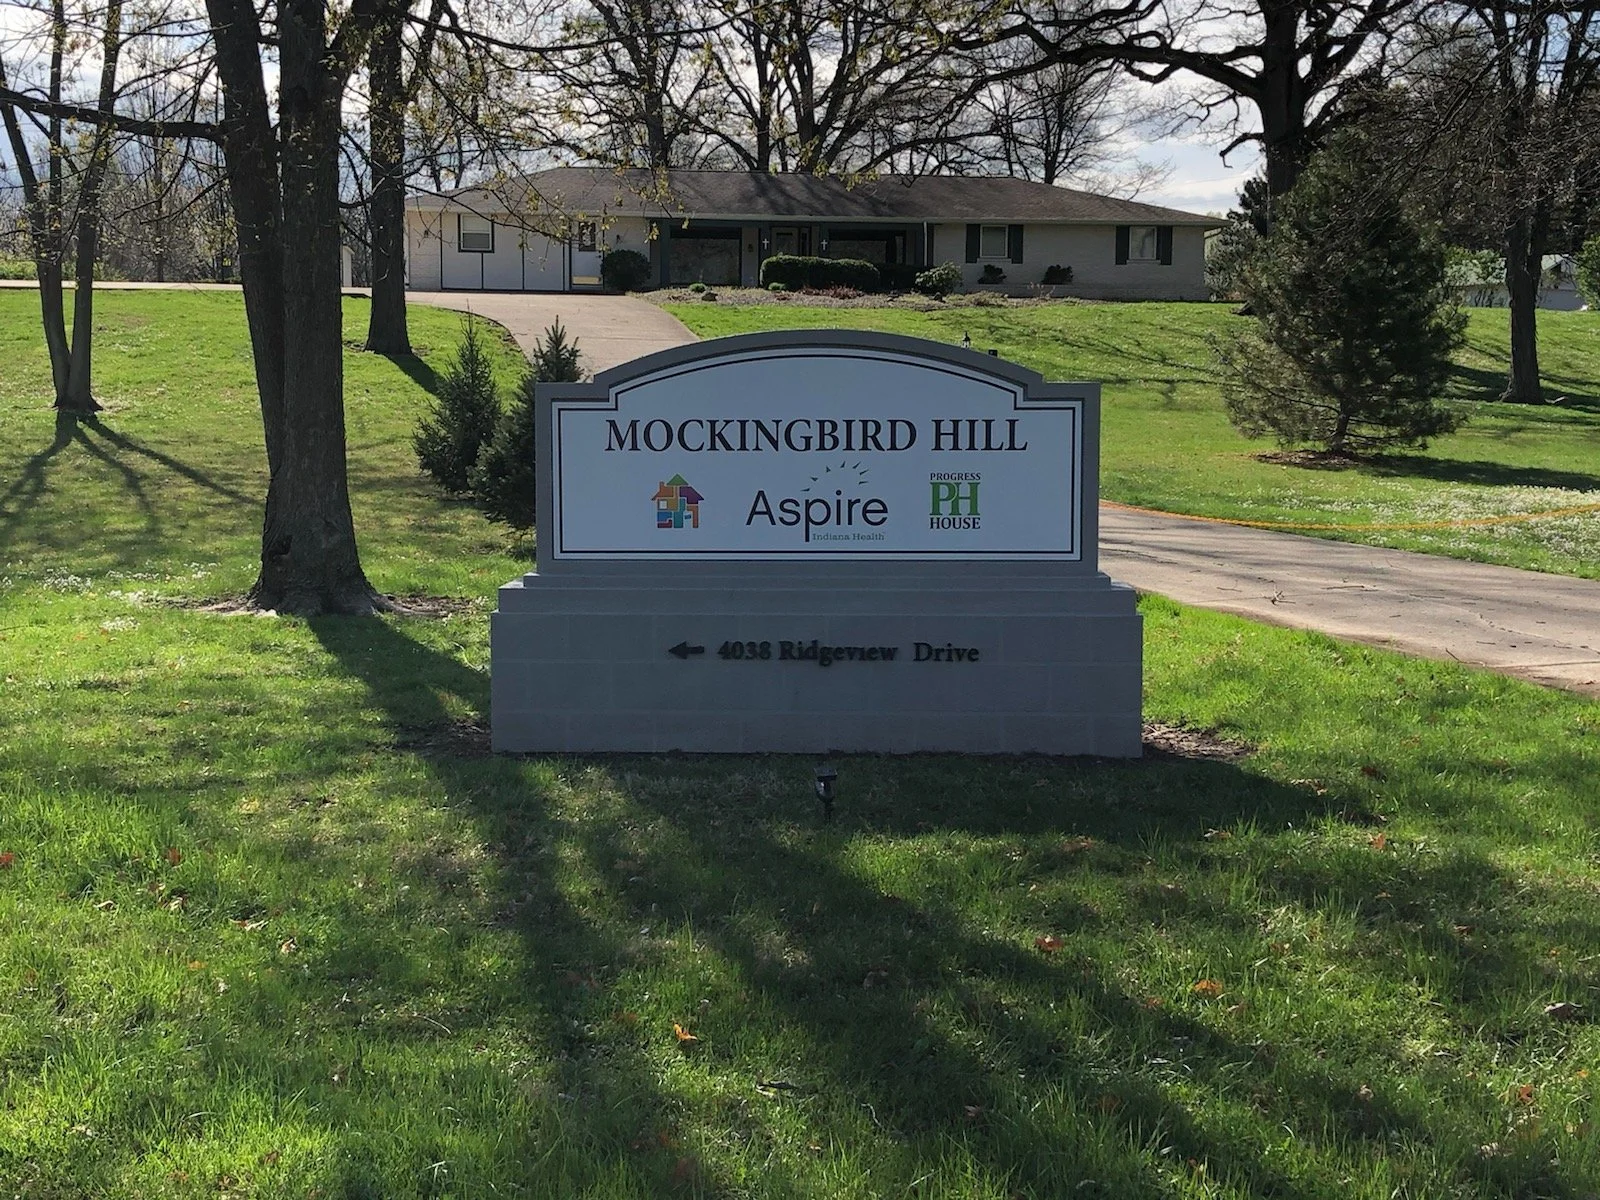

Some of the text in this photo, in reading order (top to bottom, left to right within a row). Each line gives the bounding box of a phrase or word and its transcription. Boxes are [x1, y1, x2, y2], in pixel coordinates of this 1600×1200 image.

[605, 418, 1028, 452] MOCKINGBIRD HILL
[930, 472, 982, 481] PROGRESS
[929, 481, 982, 516] PH
[746, 489, 889, 543] Aspire
[930, 517, 982, 530] HOUSE
[812, 532, 885, 541] Indiana Health
[717, 639, 980, 667] 4038 Ridgeview Drive
